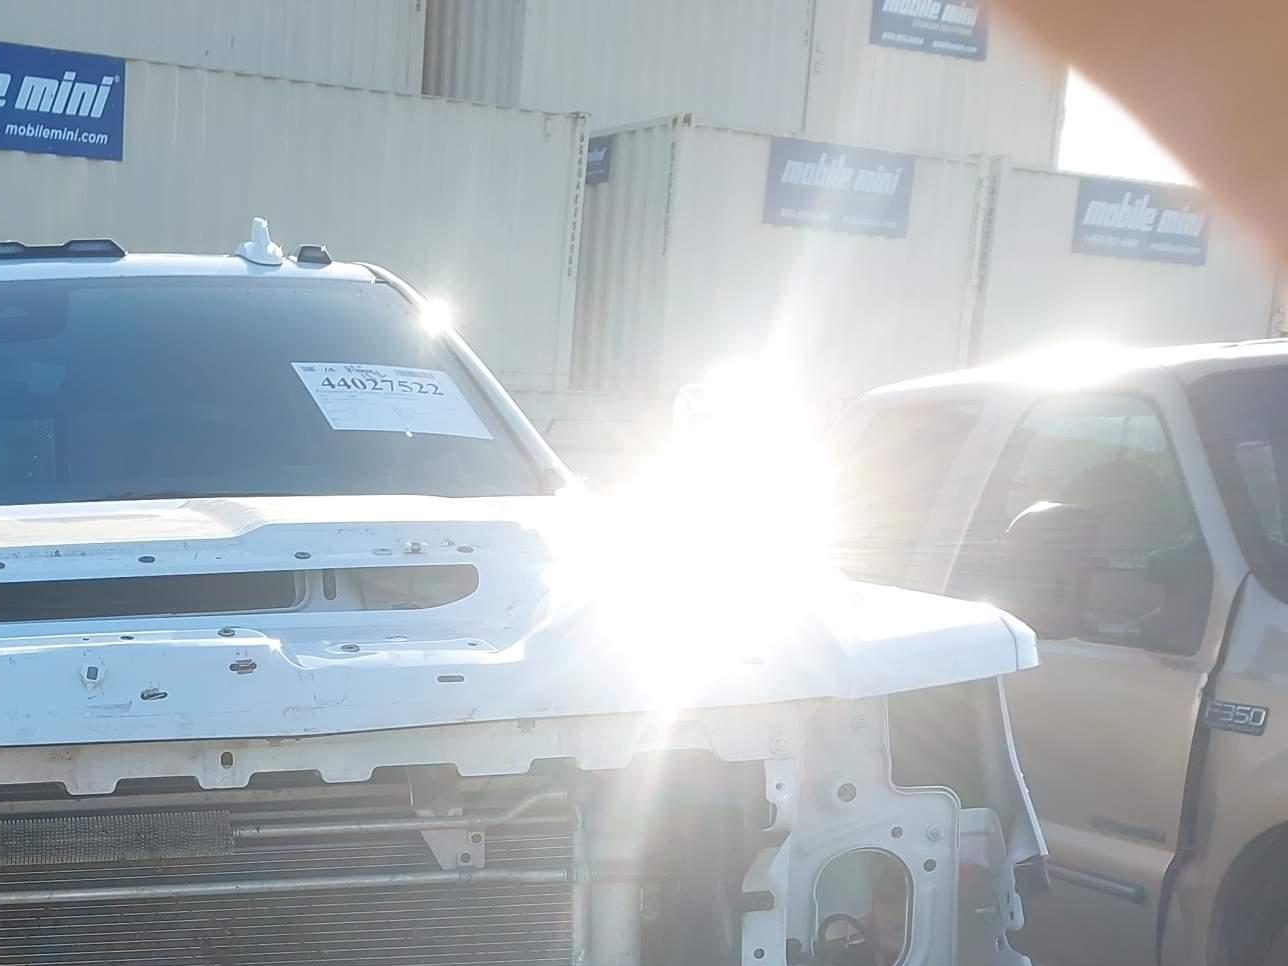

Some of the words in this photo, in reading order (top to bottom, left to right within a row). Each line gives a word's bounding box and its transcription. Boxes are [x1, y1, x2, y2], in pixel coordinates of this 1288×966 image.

[14, 70, 114, 119] mini
[4, 121, 109, 146] mobilemini.com
[781, 152, 854, 190] mobile
[853, 165, 902, 195] mini
[1082, 191, 1159, 232] mobile
[320, 376, 445, 397] 44027522
